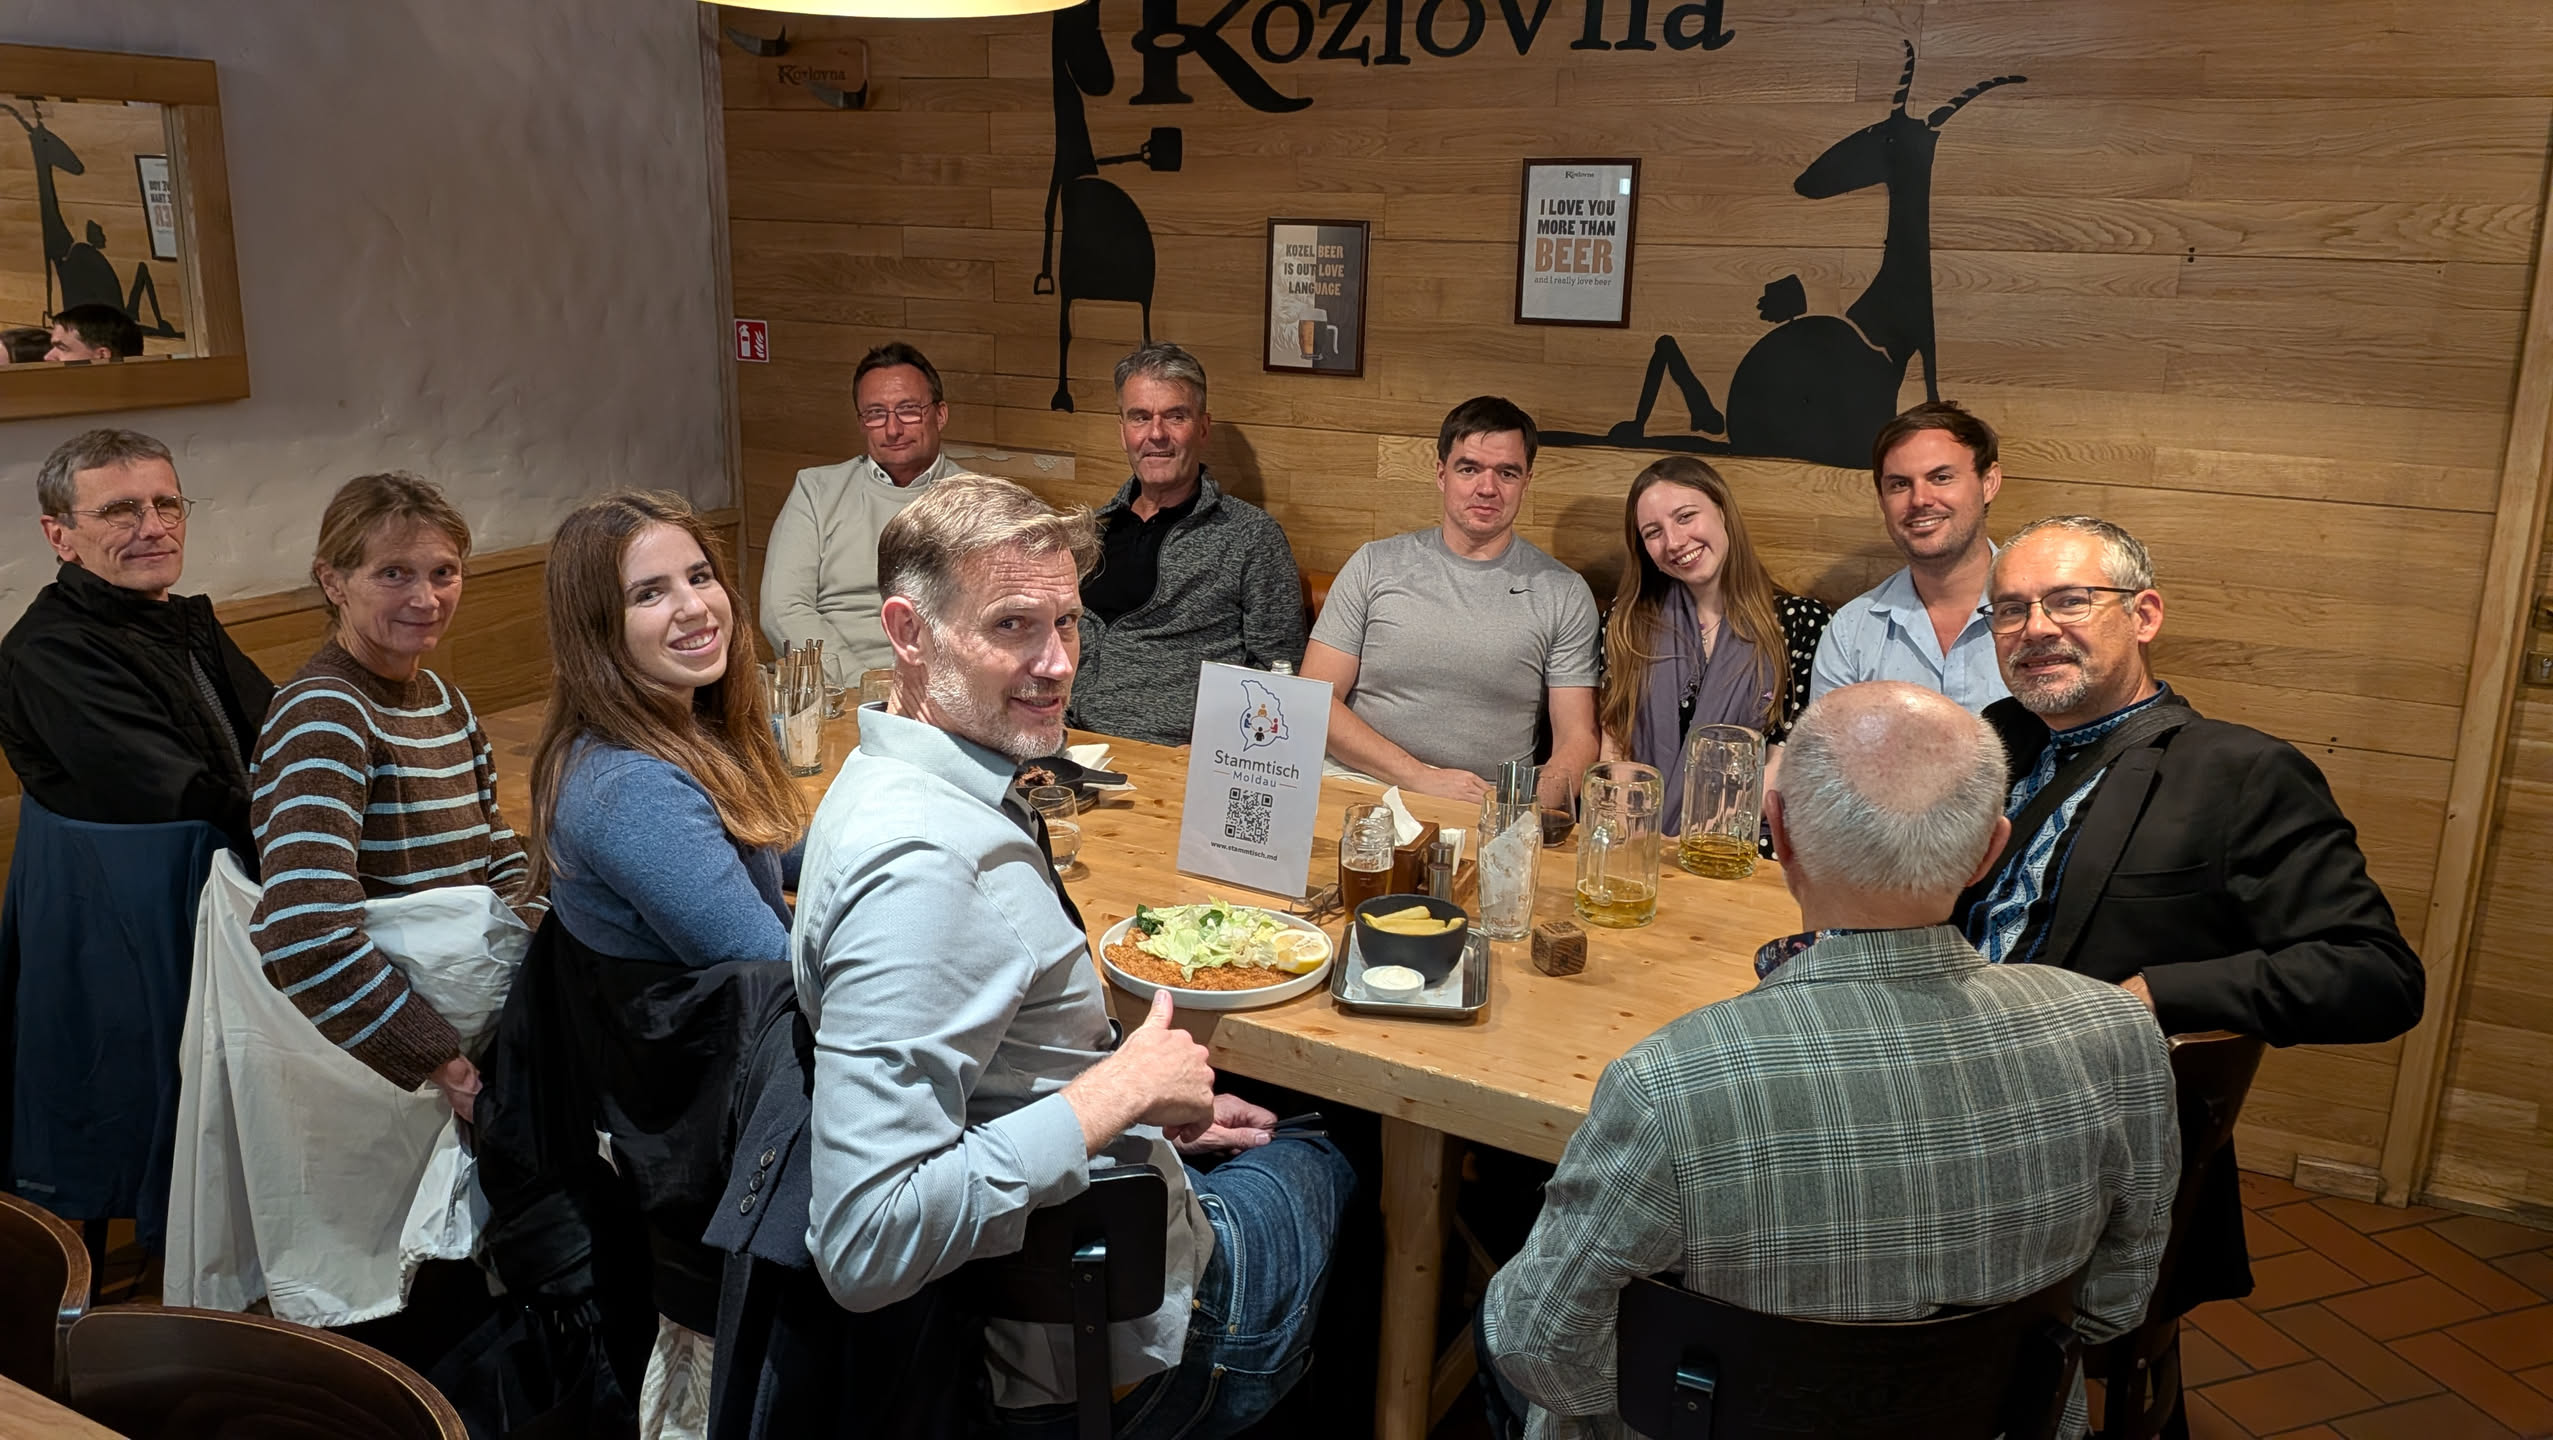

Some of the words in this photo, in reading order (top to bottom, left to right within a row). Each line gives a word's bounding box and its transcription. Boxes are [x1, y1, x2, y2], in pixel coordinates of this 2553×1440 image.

[778, 64, 846, 85] Kozlovna
[1540, 199, 1545, 215] I
[1549, 199, 1584, 216] LOVE
[1588, 200, 1616, 216] YOU
[1537, 220, 1576, 235] MORE
[1580, 220, 1616, 236] THAN
[1286, 244, 1316, 257] KOZEL
[1317, 245, 1344, 258] BEER
[1535, 237, 1613, 274] BEER
[1284, 263, 1294, 275] IS
[1318, 265, 1344, 277] LOVE
[1288, 282, 1341, 296] LANGUAGE
[1534, 276, 1549, 284] and
[1553, 276, 1575, 286] really
[1577, 277, 1593, 286] love
[1594, 278, 1612, 286] beer
[1214, 750, 1300, 780] Stammtisch
[1233, 770, 1277, 788] Moldau
[1210, 841, 1278, 861] www.stammtisch.md
